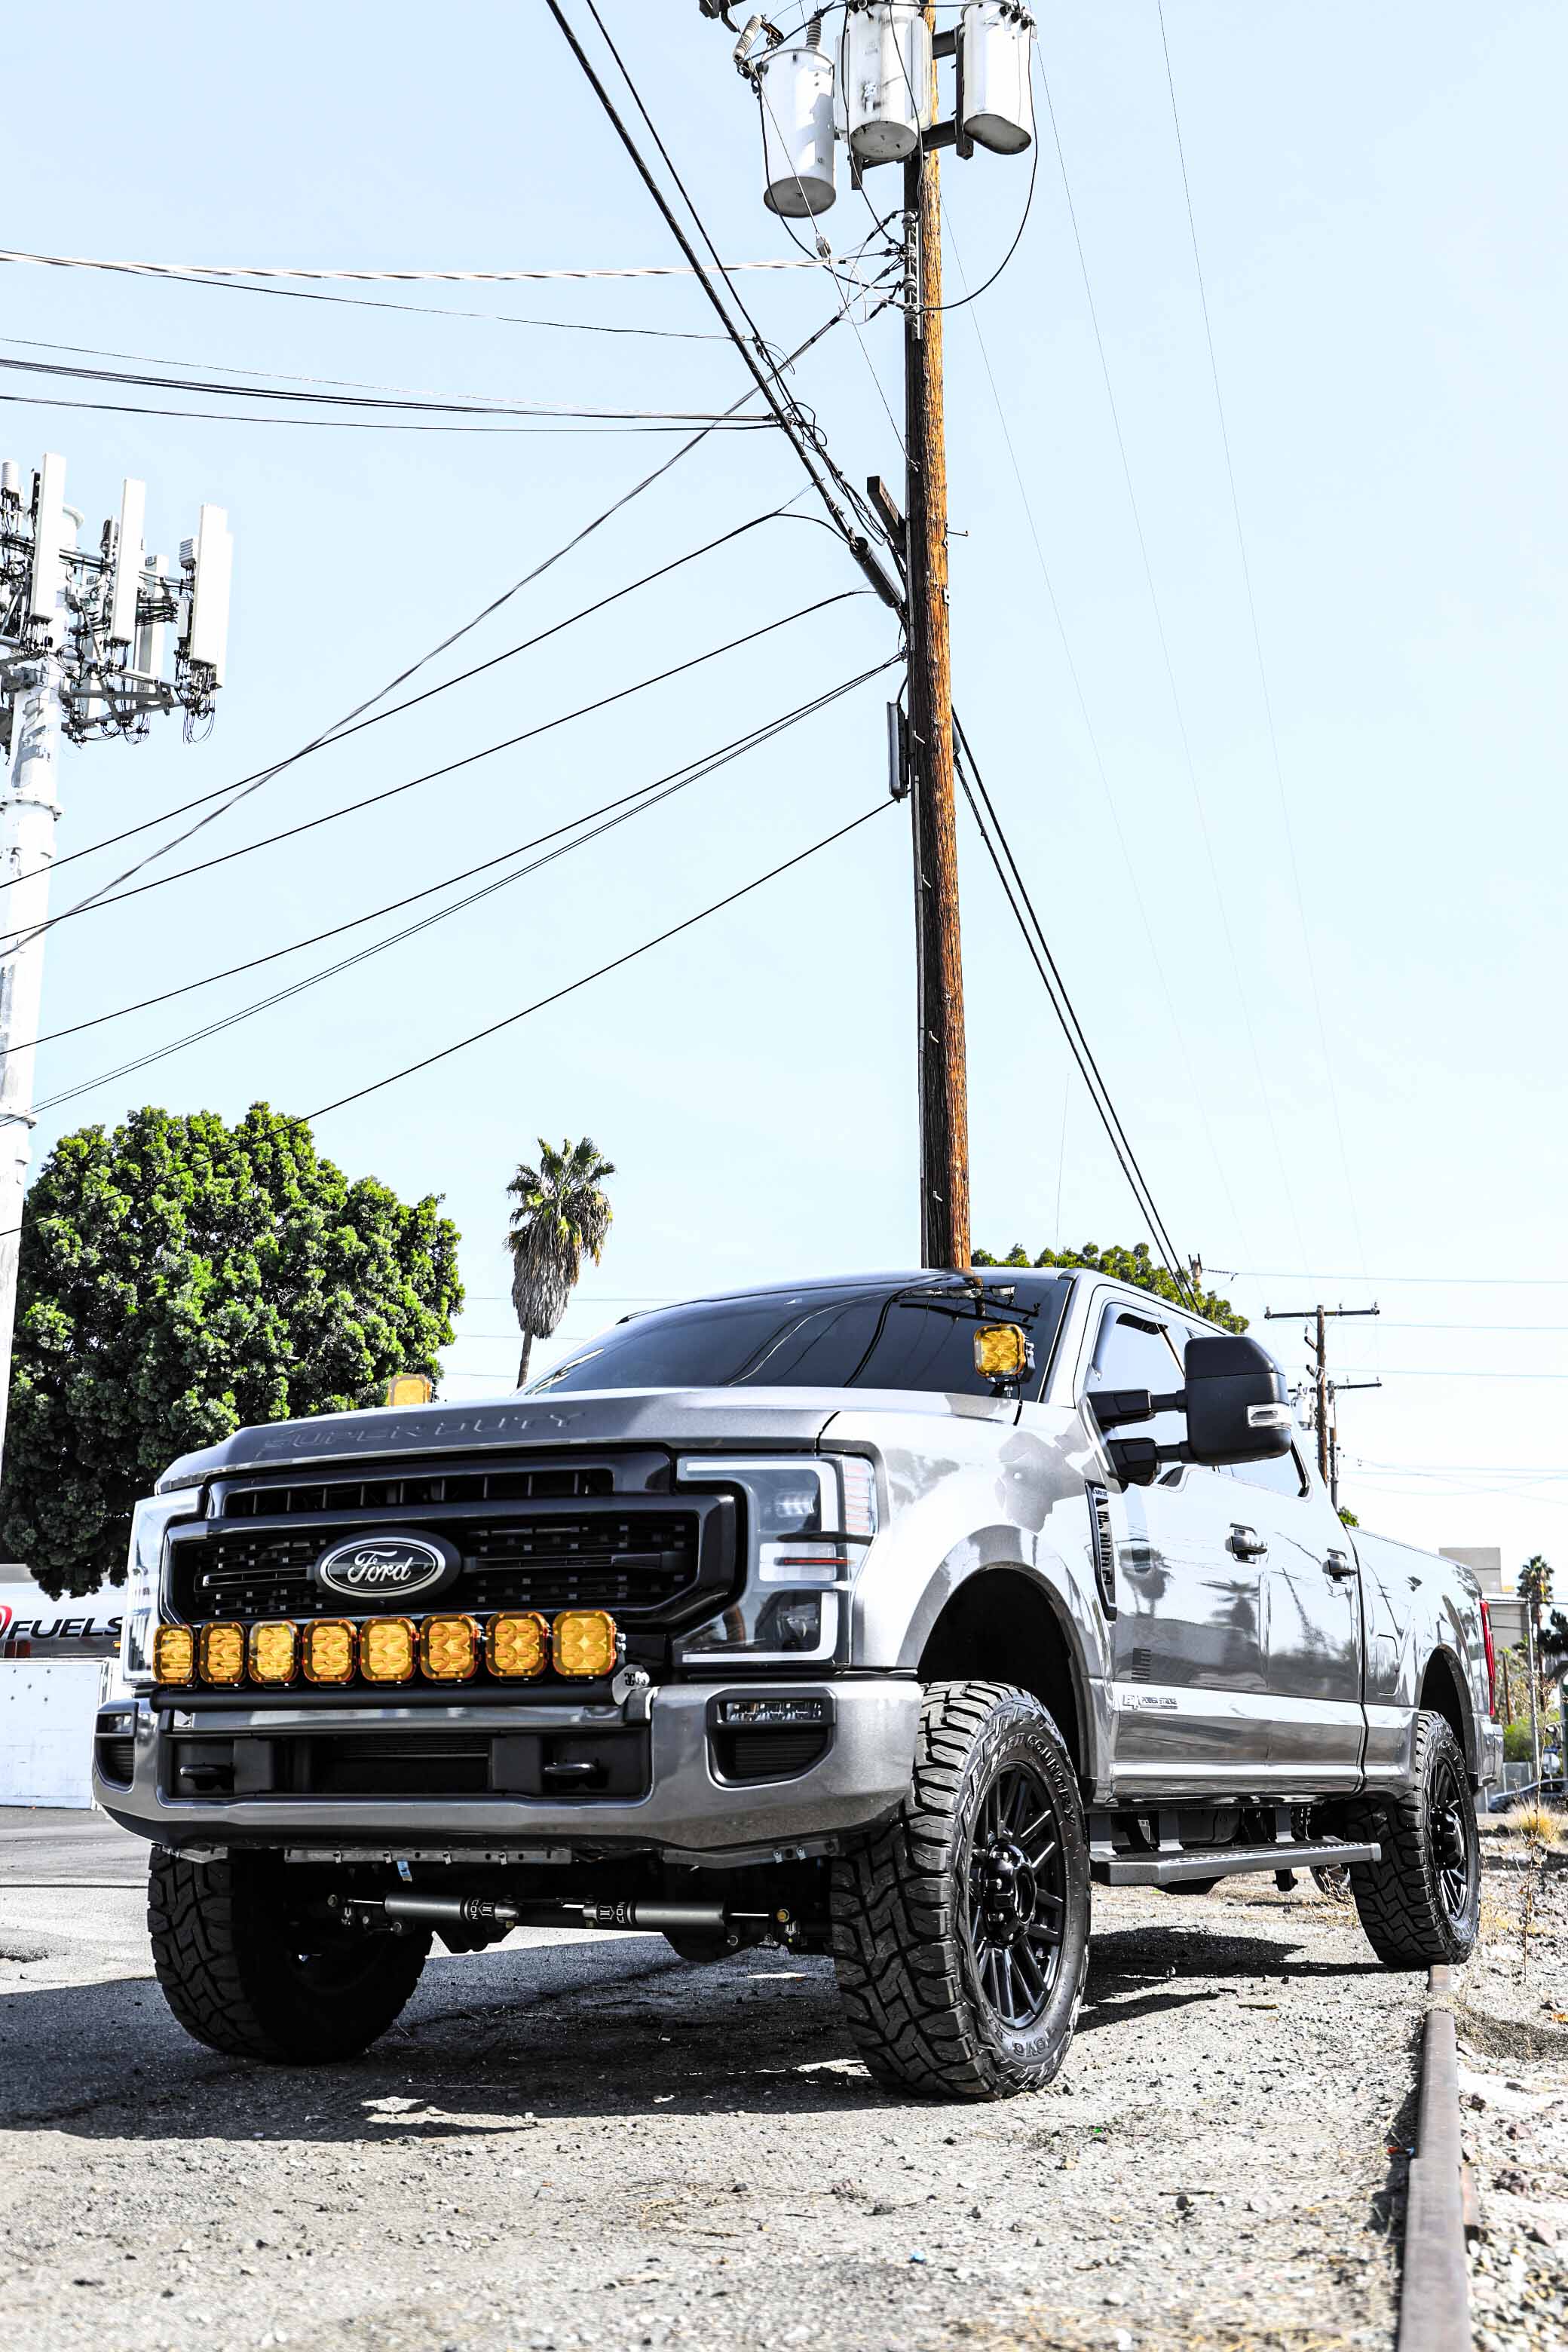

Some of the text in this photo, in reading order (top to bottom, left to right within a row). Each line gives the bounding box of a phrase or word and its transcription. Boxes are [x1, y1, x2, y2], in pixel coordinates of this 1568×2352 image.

[264, 1412, 586, 1448] SUPER DUTY
[348, 1550, 413, 1583] Ford
[8, 1616, 123, 1640] FUELS
[470, 1899, 480, 1920] CON
[616, 1900, 627, 1924] ICON
